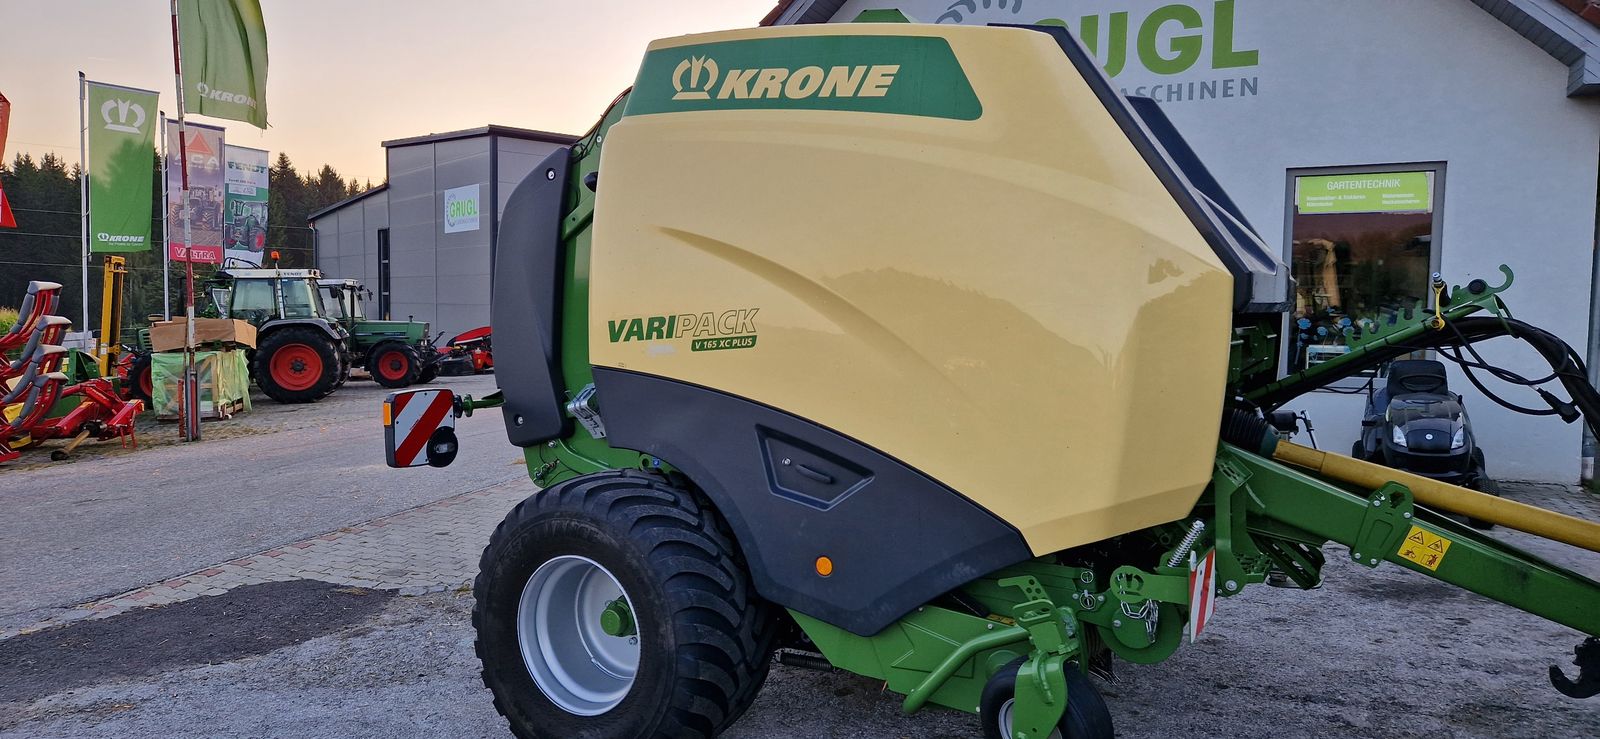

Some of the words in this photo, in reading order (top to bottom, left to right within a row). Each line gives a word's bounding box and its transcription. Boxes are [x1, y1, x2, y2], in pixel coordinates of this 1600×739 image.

[1034, 0, 1259, 78] UGL
[717, 65, 900, 99] KRONE
[210, 89, 257, 110] KRON
[227, 161, 267, 173] FENDT
[1327, 179, 1400, 190] GARTENTECHNIK
[450, 199, 477, 217] GAUGL
[608, 308, 760, 343] VARIPACK
[695, 341, 702, 349] V
[703, 340, 717, 349] 165
[718, 339, 731, 348] XC
[732, 337, 752, 347] PLUS
